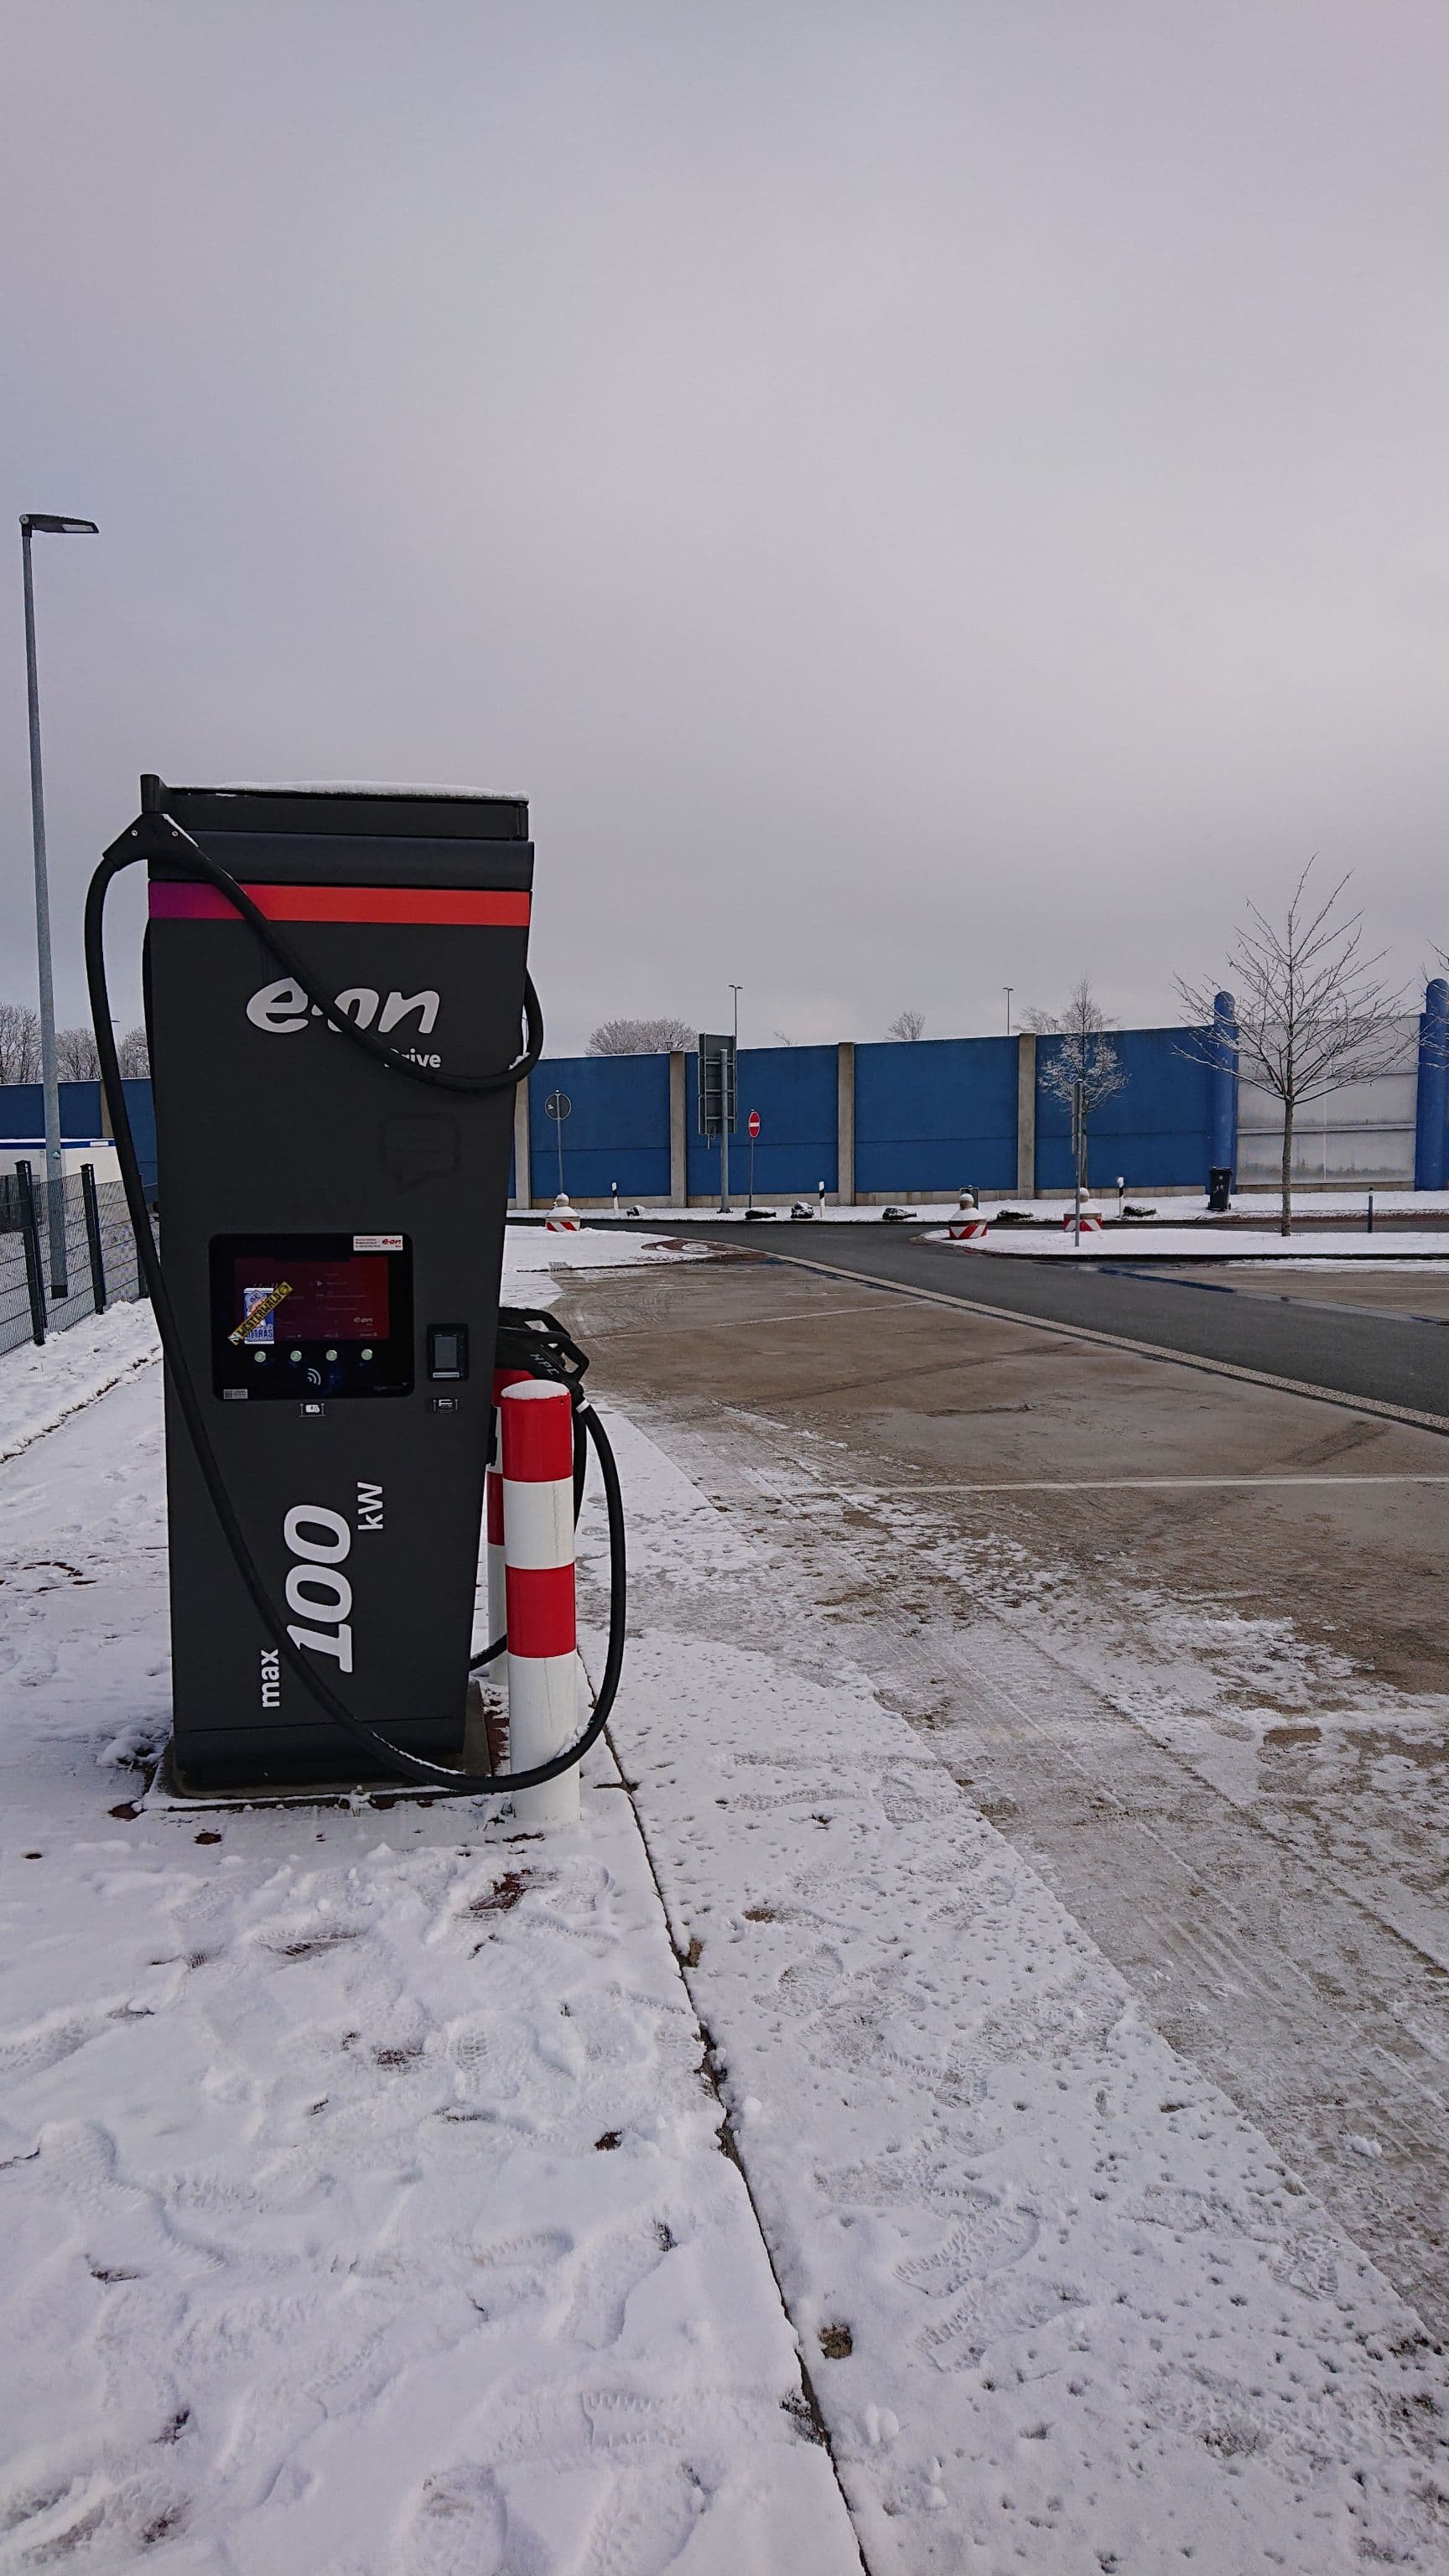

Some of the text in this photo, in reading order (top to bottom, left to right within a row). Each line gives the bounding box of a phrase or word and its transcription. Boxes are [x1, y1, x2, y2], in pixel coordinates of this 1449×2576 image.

[236, 1293, 282, 1337] WESTERWALD
[357, 1482, 384, 1530] kW
[283, 1504, 353, 1673] 100
[260, 1649, 281, 1708] max
